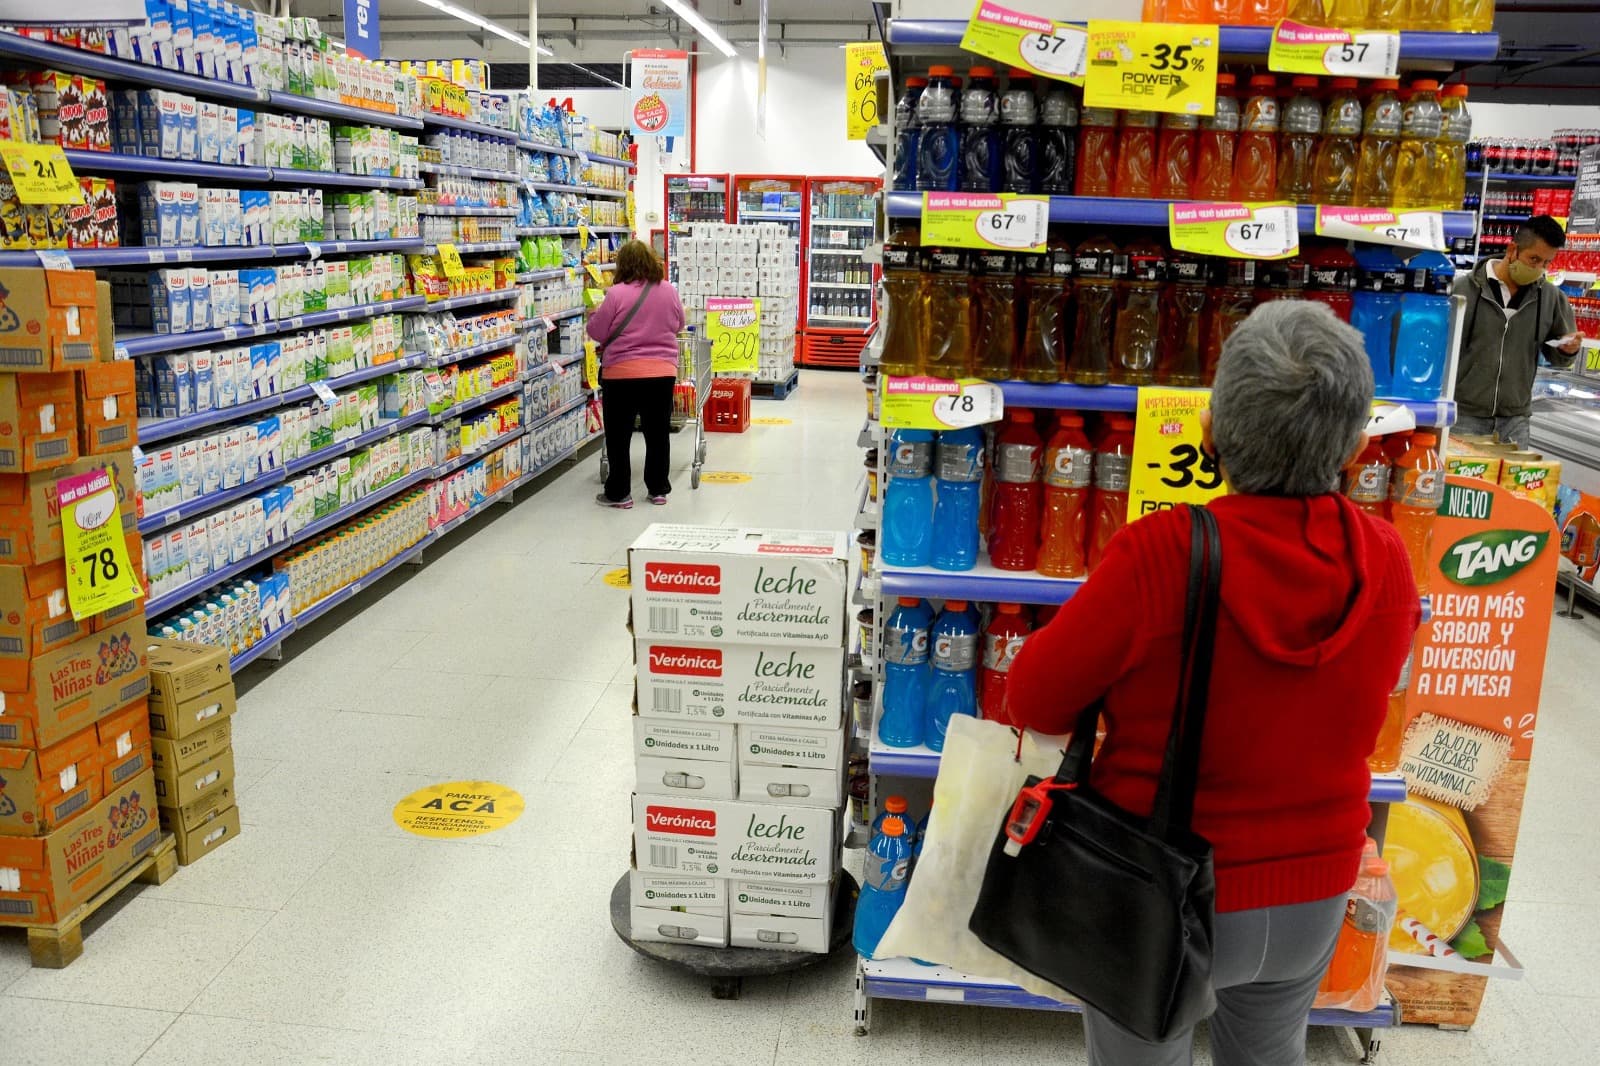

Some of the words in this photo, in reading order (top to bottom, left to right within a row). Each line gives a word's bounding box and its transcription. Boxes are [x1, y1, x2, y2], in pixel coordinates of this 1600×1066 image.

[1036, 33, 1066, 53] 57
[1341, 43, 1369, 62] 57
[1122, 72, 1182, 85] POWER
[1122, 84, 1154, 95] ADE
[929, 199, 950, 208] Mirá
[951, 199, 967, 208] qué
[968, 199, 1001, 208] bueno!
[991, 214, 1014, 229] 67
[1176, 210, 1197, 220] Mirá
[1199, 208, 1214, 218] qué
[1216, 208, 1249, 218] bueno!
[1240, 224, 1263, 240] 67
[889, 382, 909, 390] Mirá
[927, 383, 959, 392] bueno!
[948, 394, 974, 412] 78
[896, 445, 914, 463] G
[1055, 452, 1073, 474] G
[1358, 469, 1378, 488] G
[1416, 473, 1436, 493] G
[1518, 469, 1546, 483] TANG
[1448, 487, 1488, 519] NUEVO
[1452, 535, 1537, 579] TANG
[83, 547, 119, 588] 78
[646, 569, 720, 587] Verónica
[754, 566, 816, 595] leche
[753, 598, 815, 611] Parcialmente
[1430, 593, 1478, 618] LLEVA
[1483, 590, 1525, 619] MÁS
[737, 603, 829, 625] descremada
[737, 630, 769, 638] Fortificada
[782, 631, 814, 640] Vitaminas
[1432, 622, 1490, 644] SABOR
[1501, 623, 1514, 645] Y
[936, 639, 950, 657] G
[650, 653, 722, 669] Verónica
[755, 651, 816, 678] leche
[1421, 644, 1515, 671] DIVERSIÓN
[50, 665, 69, 685] Las
[69, 658, 92, 673] Tres
[53, 674, 93, 702] Niñas
[753, 681, 813, 694] Parcialmente
[1417, 673, 1430, 695] A
[1435, 674, 1457, 696] LA
[1461, 674, 1511, 697] MESA
[738, 686, 828, 707] descremada
[737, 710, 769, 719] Fortificada
[782, 713, 813, 721] Vitaminas
[180, 745, 189, 757] 12
[656, 740, 689, 750] Unidades
[701, 744, 719, 752] Litro
[1433, 730, 1463, 751] BAJO
[1465, 736, 1482, 756] EN
[761, 747, 794, 757] Unidades
[808, 752, 826, 760] Litro
[1420, 743, 1478, 773] AZÚCARES
[1402, 763, 1417, 775] CON
[1416, 764, 1463, 794] VITAMINA
[1464, 780, 1476, 796] C
[421, 797, 496, 813] ACÁ
[446, 792, 492, 800] PARATE
[414, 820, 491, 830] DISTANCIAMIENTO
[415, 815, 486, 825] RESPETEMOS
[646, 812, 716, 830] Verónica
[747, 813, 805, 840] leche
[63, 838, 82, 858] Las
[81, 825, 103, 842] Tres
[746, 841, 803, 854] Parcialmente
[66, 840, 105, 875] Niñas
[731, 845, 817, 866] descremada
[892, 864, 906, 880] G
[749, 896, 780, 906] Unidades
[793, 900, 811, 908] Litro
